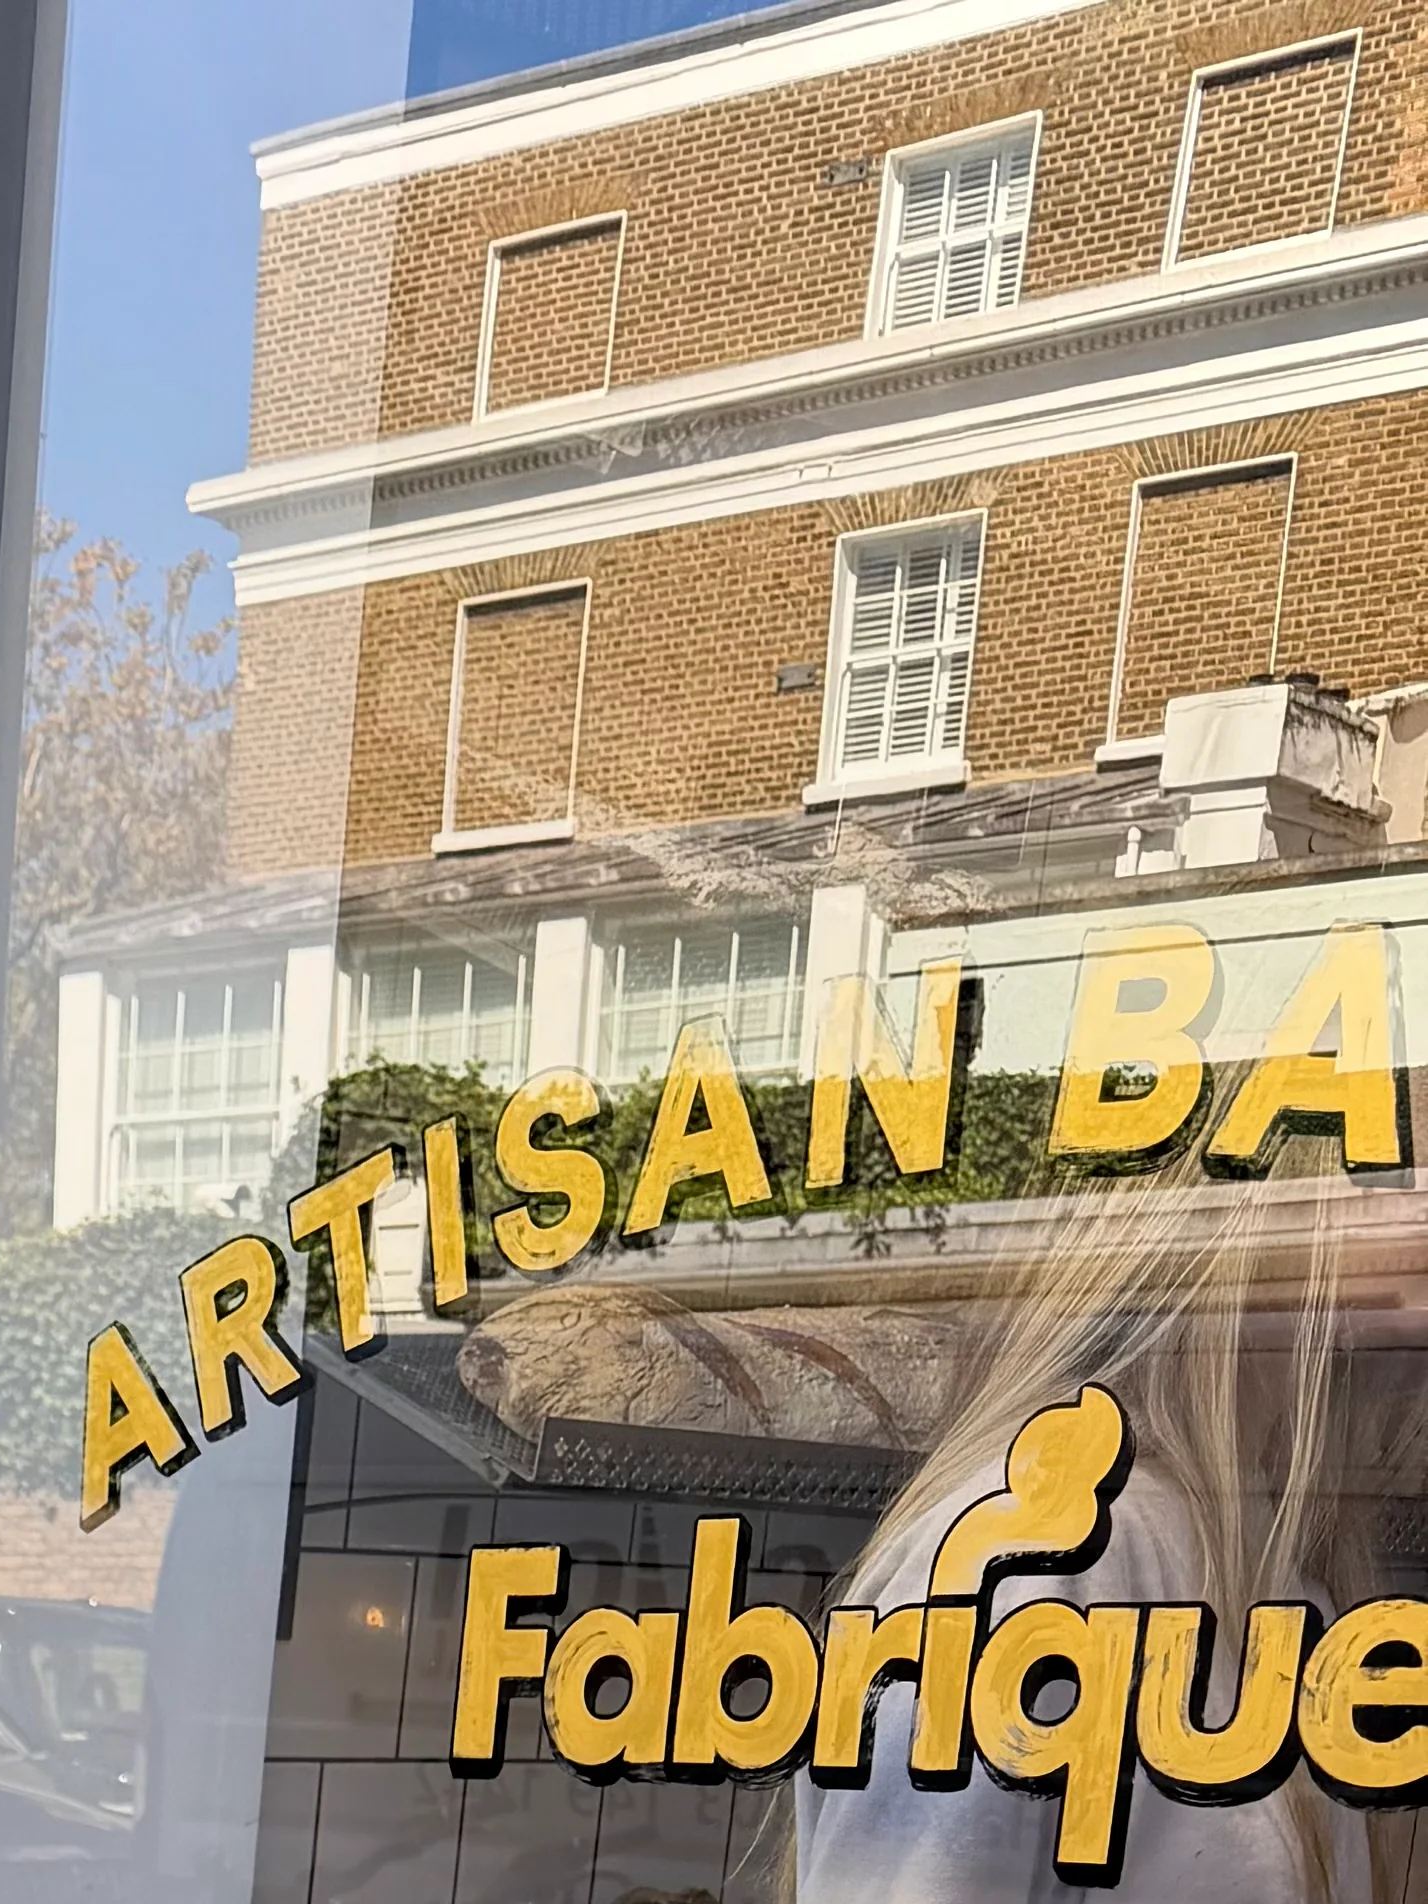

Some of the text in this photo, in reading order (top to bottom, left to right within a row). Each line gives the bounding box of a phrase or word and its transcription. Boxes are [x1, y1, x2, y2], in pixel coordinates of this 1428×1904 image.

[80, 919, 1414, 1530] ARTISAN BA
[449, 1383, 1428, 1890] Fabrique
